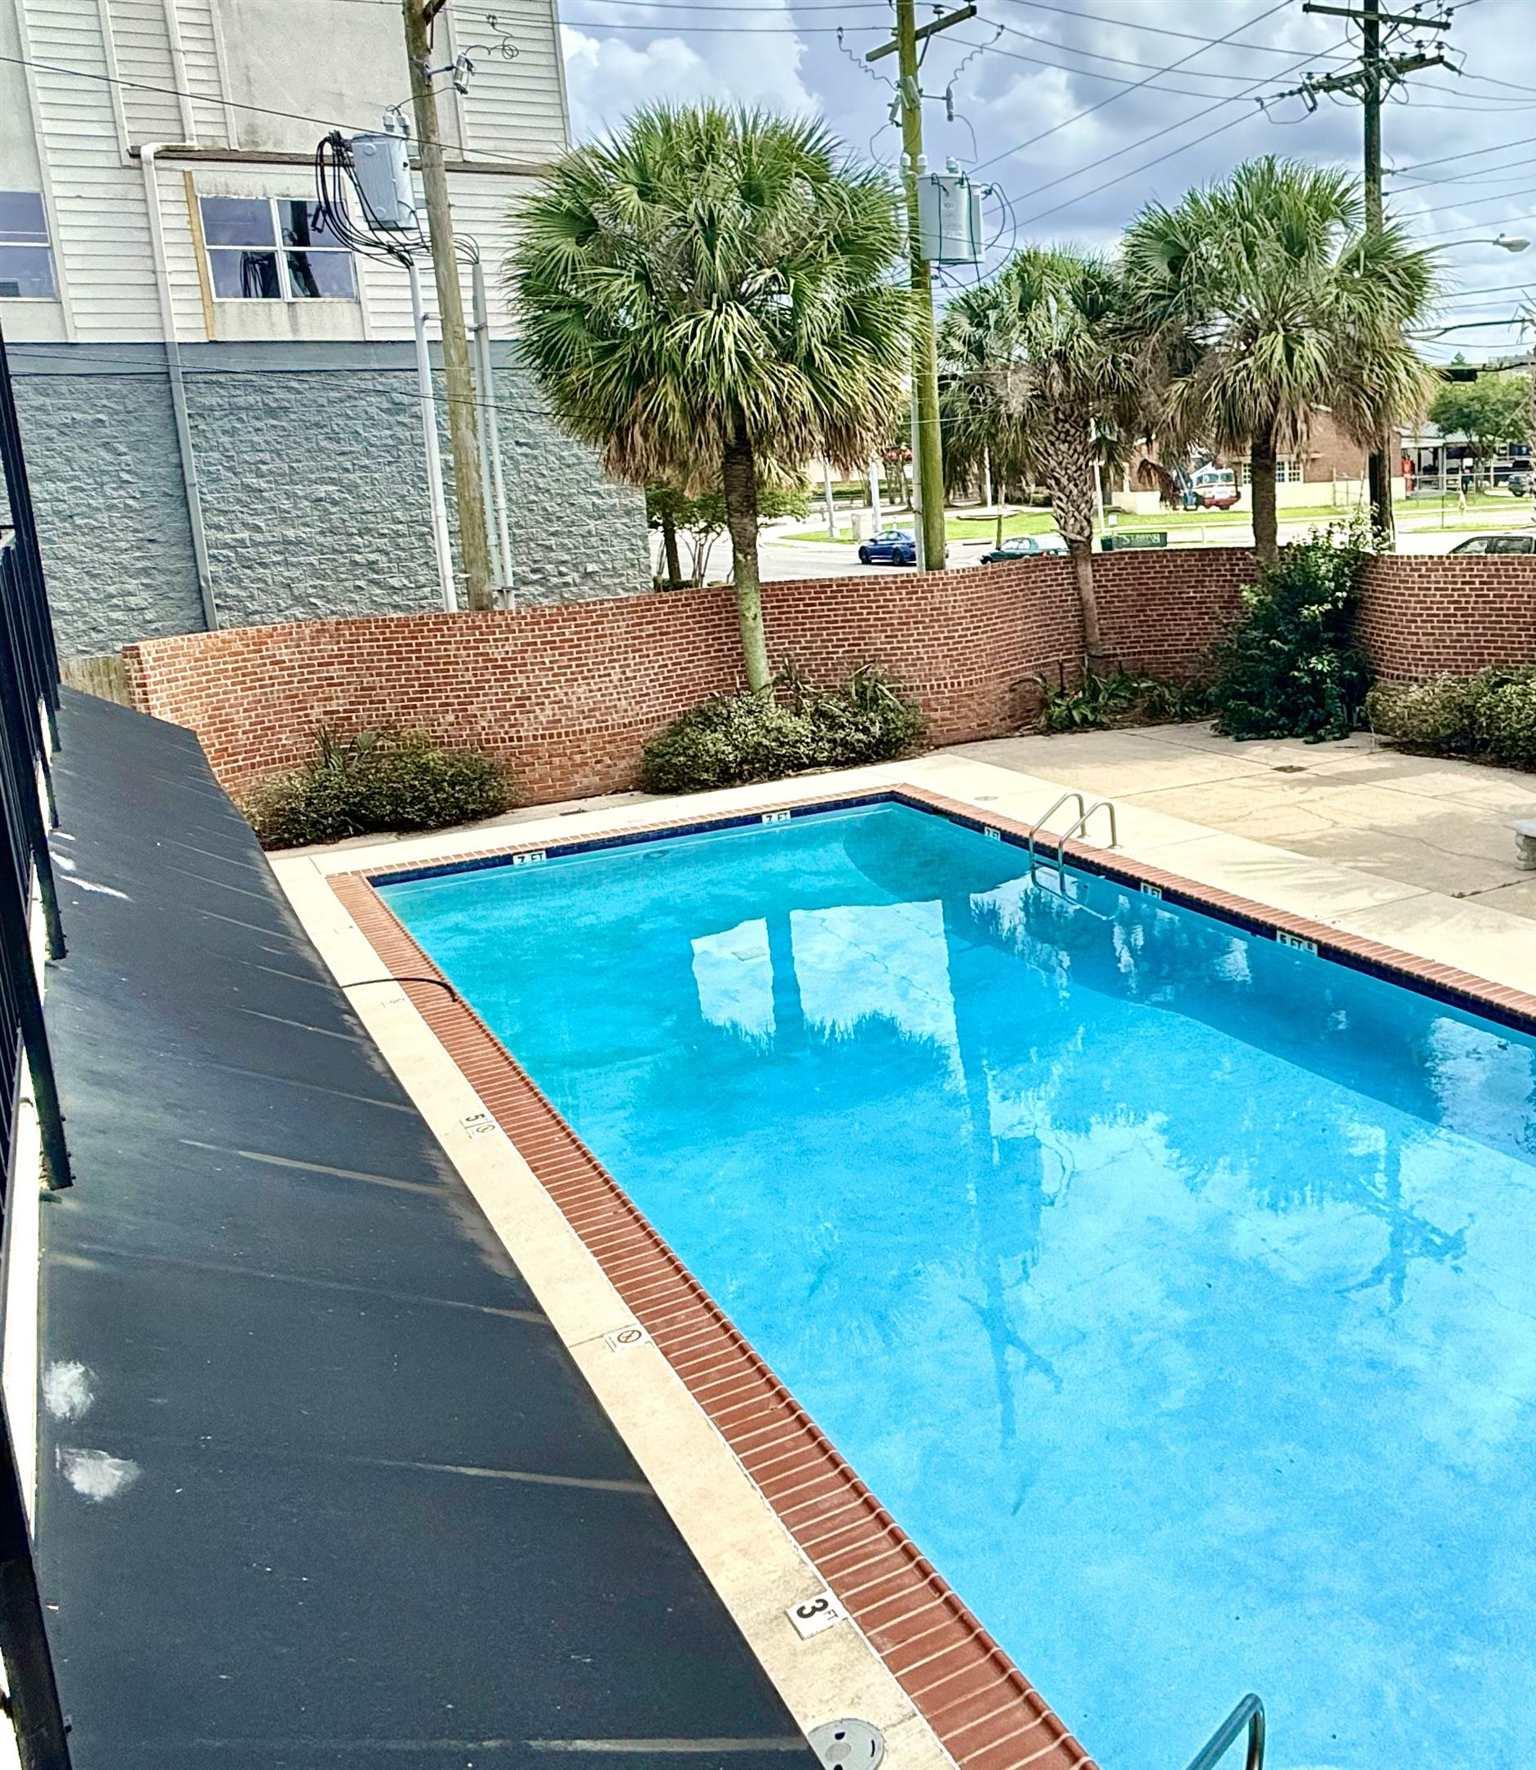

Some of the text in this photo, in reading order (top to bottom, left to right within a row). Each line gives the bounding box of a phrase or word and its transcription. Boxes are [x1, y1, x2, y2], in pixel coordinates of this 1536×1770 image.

[517, 852, 544, 864] 7 FT
[1290, 938, 1303, 950] FT
[796, 1598, 829, 1619] 3
